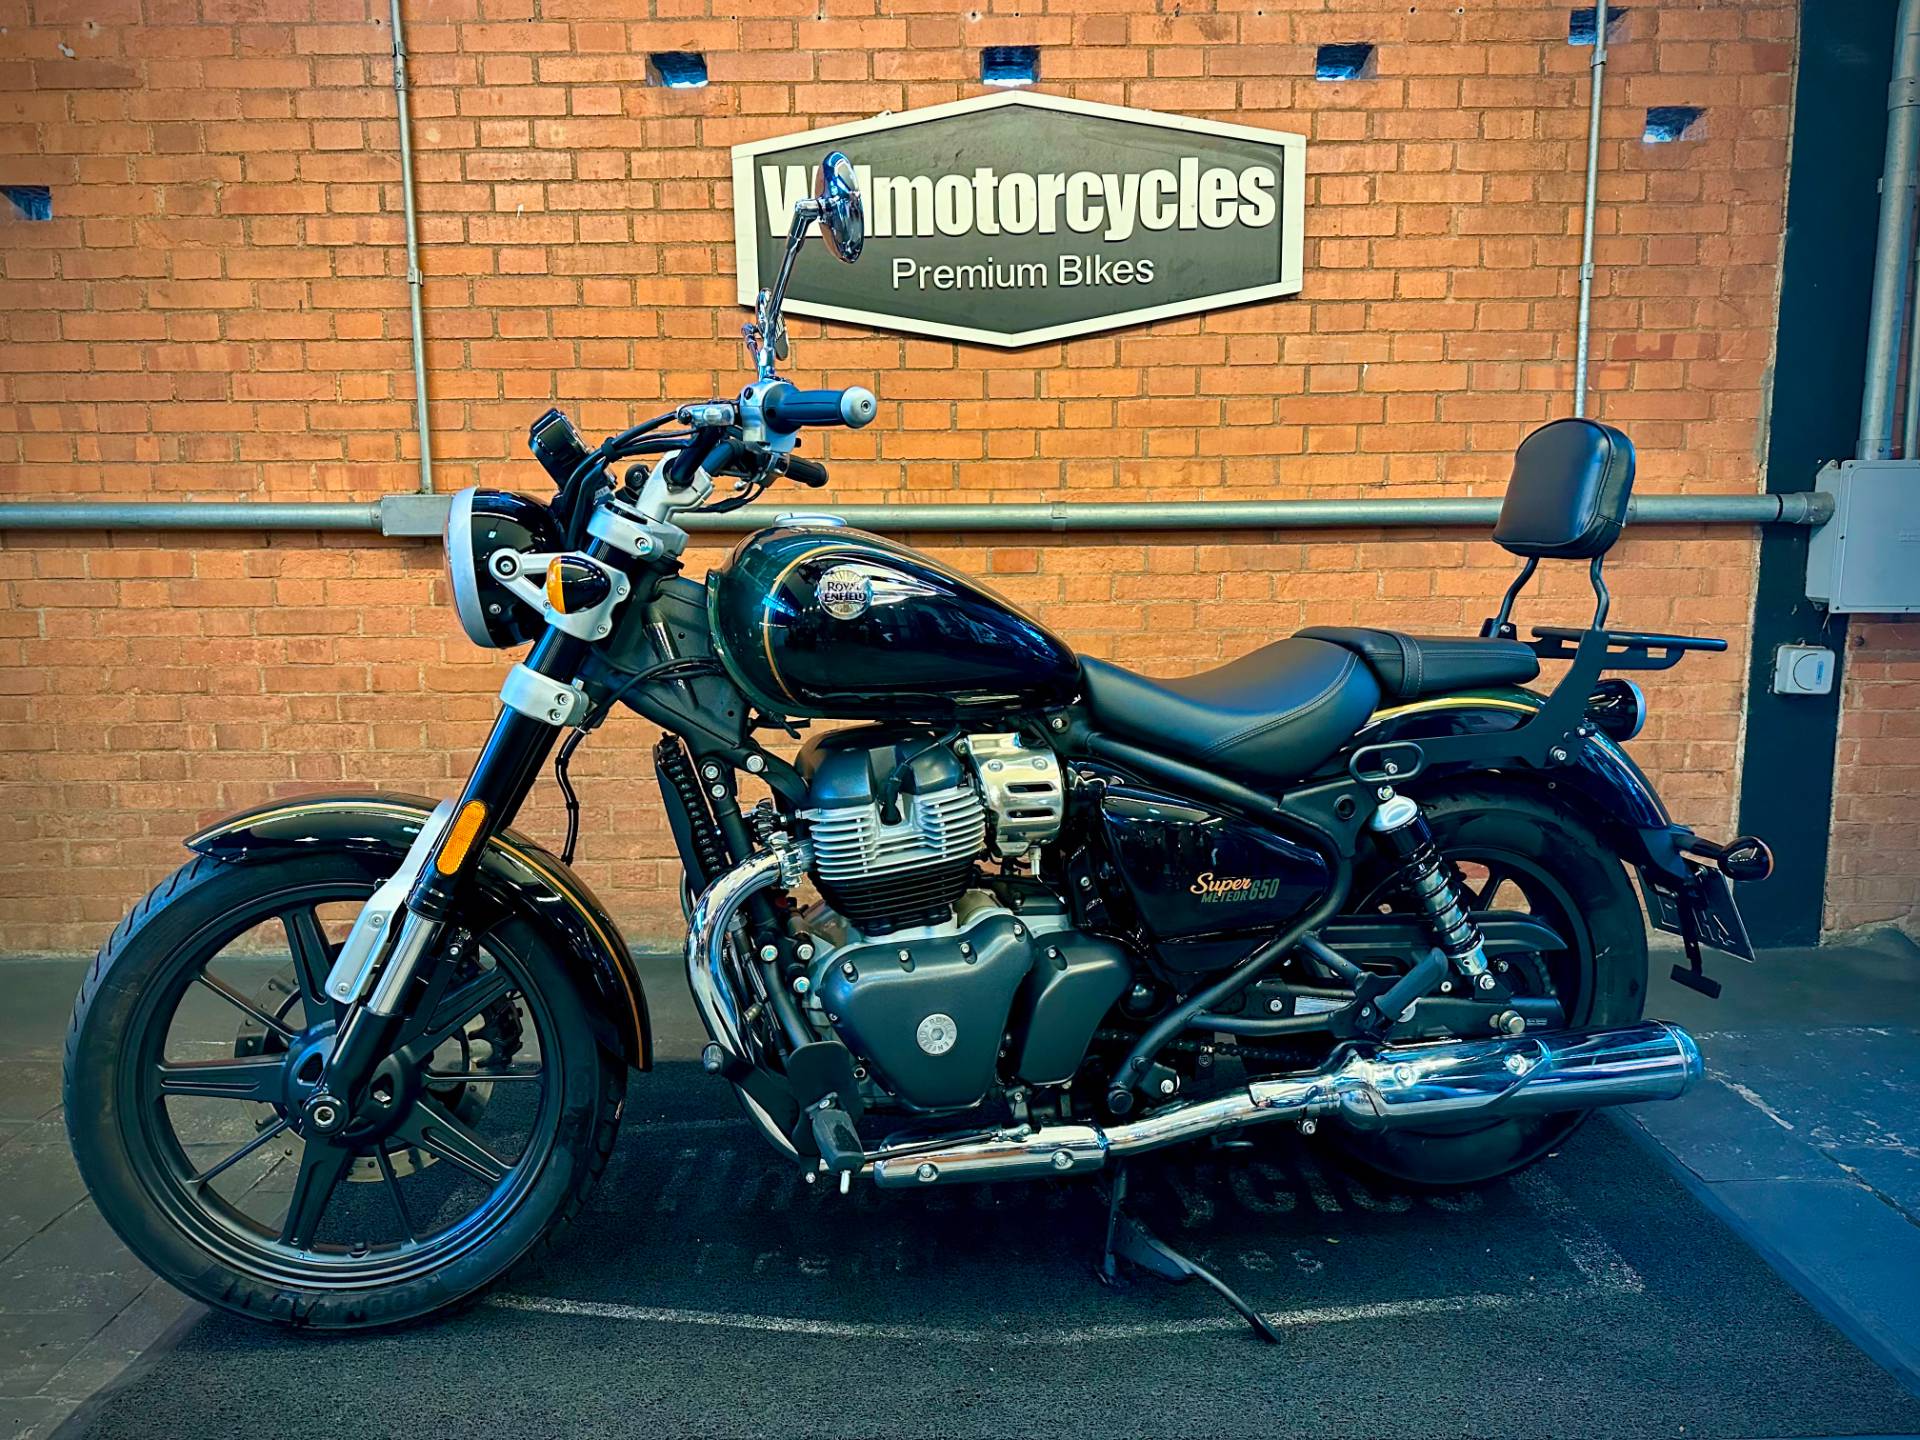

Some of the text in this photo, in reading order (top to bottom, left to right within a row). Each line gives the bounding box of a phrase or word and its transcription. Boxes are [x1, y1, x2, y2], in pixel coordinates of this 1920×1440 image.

[761, 157, 1276, 241] Wlmotorcycles
[891, 256, 1048, 289] Premium
[824, 592, 868, 602] ENFIELD
[1190, 872, 1252, 896] Super
[1201, 878, 1280, 903] METEOR 650
